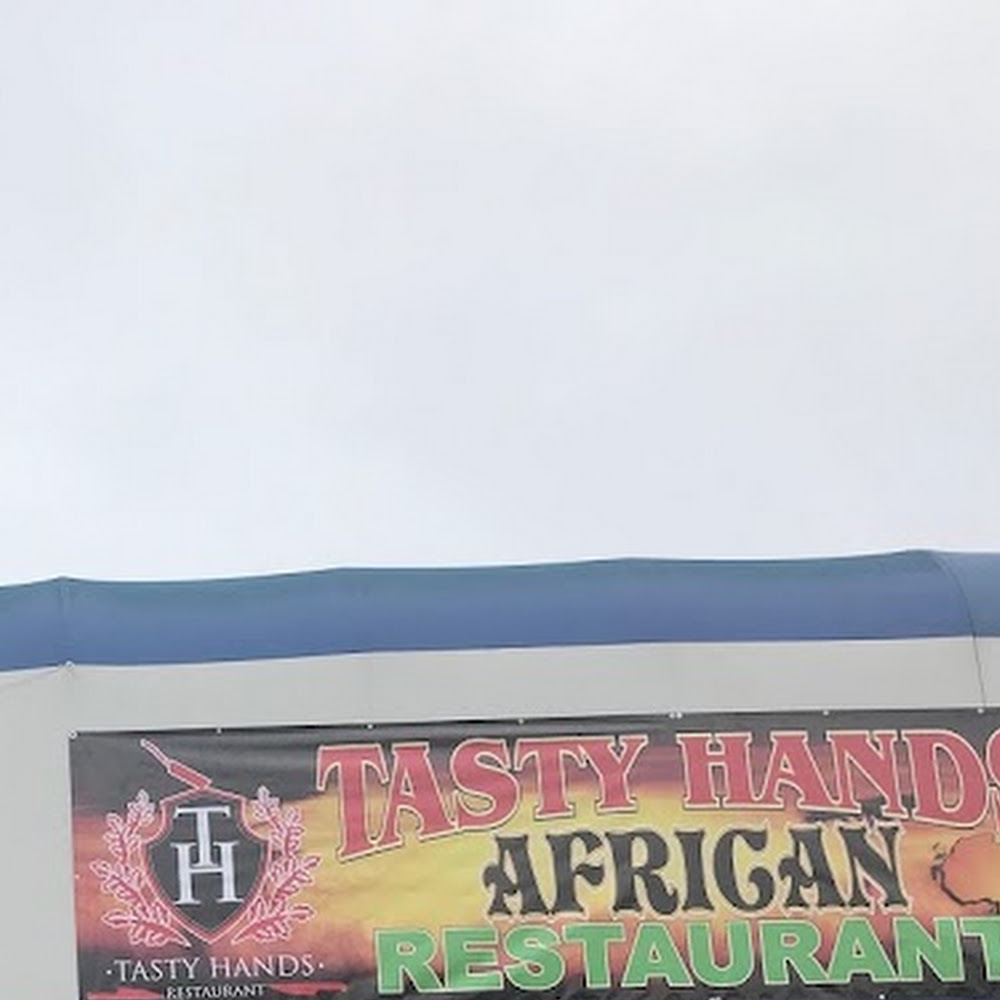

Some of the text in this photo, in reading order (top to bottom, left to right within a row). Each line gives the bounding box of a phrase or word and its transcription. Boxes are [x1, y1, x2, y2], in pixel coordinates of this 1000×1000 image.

[316, 728, 1000, 863] TASTY HAND
[482, 824, 909, 916] AFRICAN
[113, 953, 317, 983] TASTY HANDS
[166, 983, 265, 1000] RESTAURANT
[373, 916, 1000, 994] RESTAURANT
